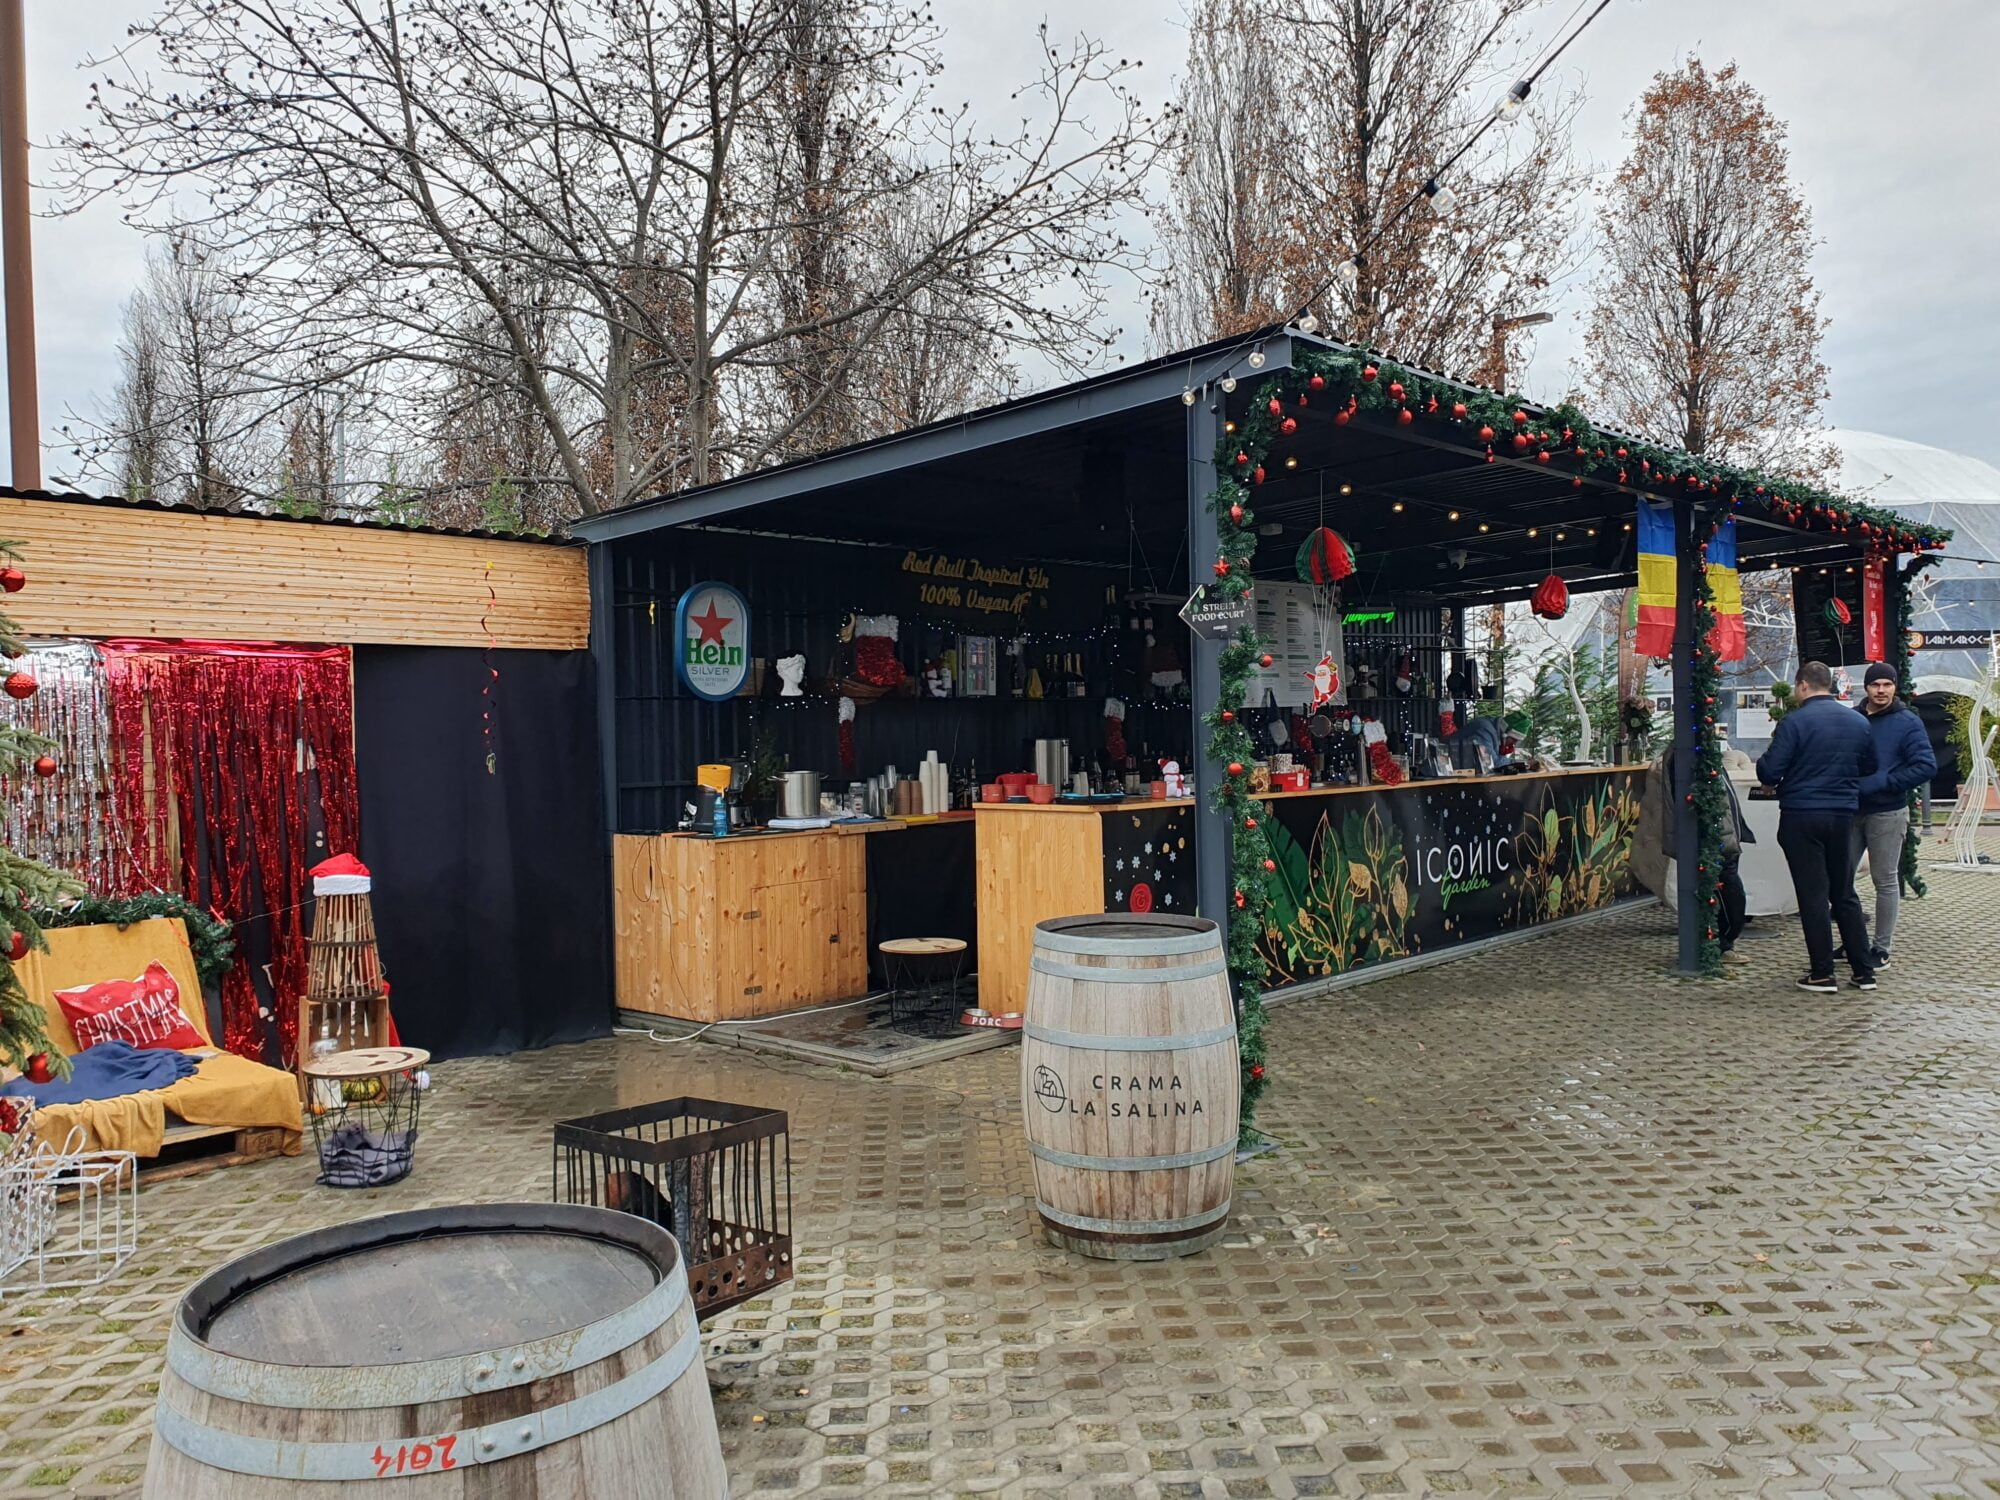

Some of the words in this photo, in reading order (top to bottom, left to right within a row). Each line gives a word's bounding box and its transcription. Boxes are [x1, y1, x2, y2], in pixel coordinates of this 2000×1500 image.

[902, 551, 932, 574] Red
[933, 555, 966, 578] Bull
[967, 559, 1023, 587] Tropical
[920, 584, 961, 607] 100%
[1202, 602, 1236, 612] STREET
[1192, 613, 1216, 622] FOOD
[1217, 610, 1245, 620] COURT
[687, 638, 742, 665] Hein
[691, 667, 730, 675] SILVER
[1416, 837, 1510, 886] ICONIC
[1440, 865, 1491, 911] Garden
[75, 988, 185, 1052] CHRISTMAS
[1092, 1075, 1182, 1091] CRAMA
[1070, 1099, 1096, 1116] LA
[1111, 1099, 1203, 1118] SALINA
[370, 1434, 458, 1477] 2014
